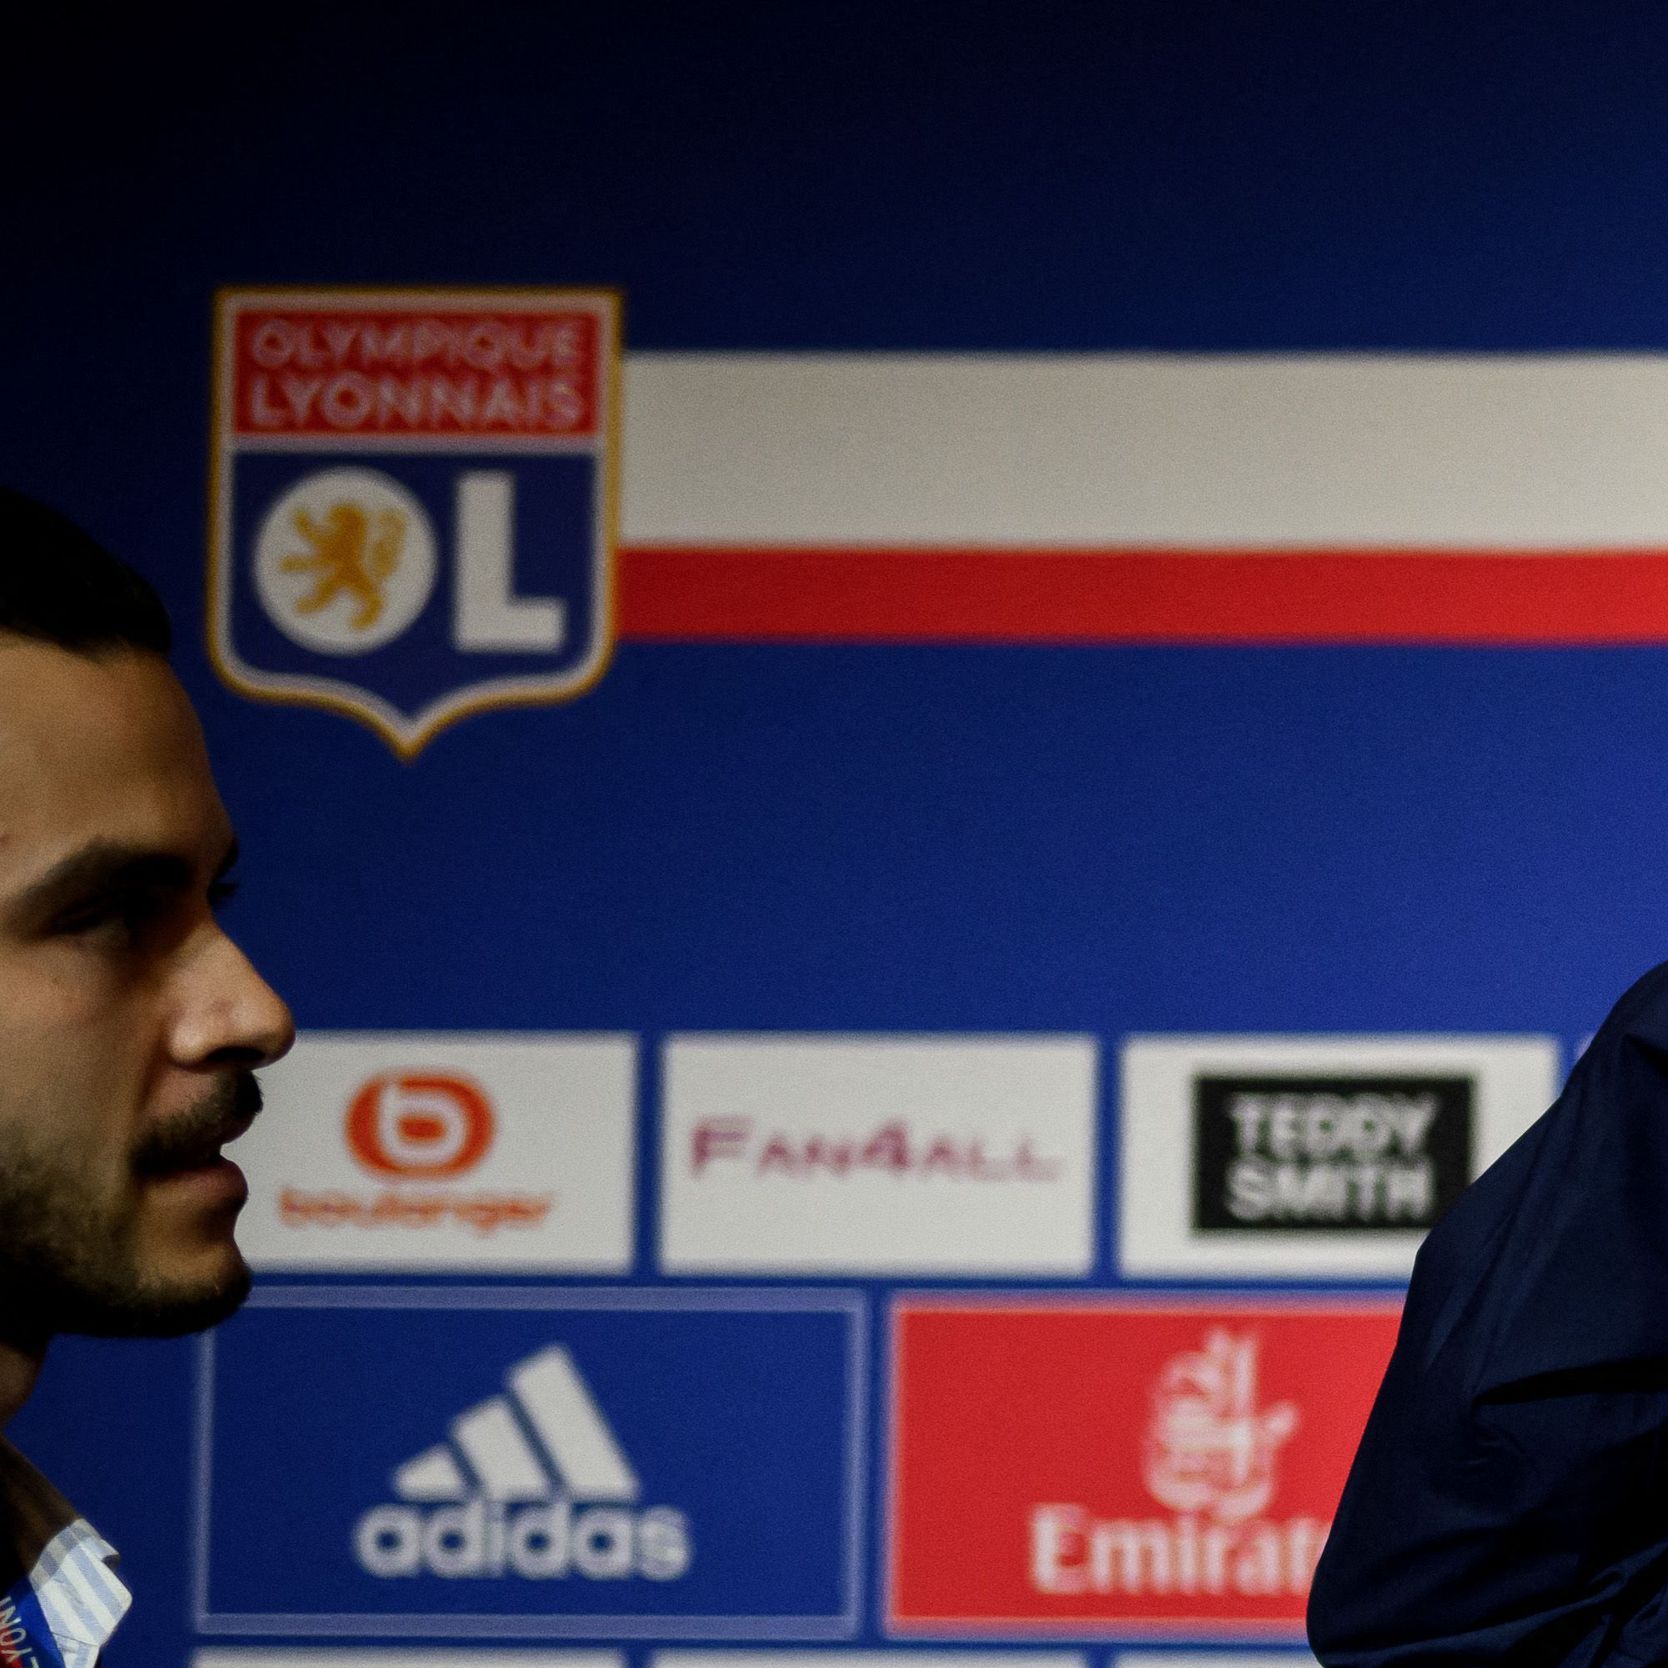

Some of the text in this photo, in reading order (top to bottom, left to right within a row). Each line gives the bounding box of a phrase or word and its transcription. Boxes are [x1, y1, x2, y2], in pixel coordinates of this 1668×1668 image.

[250, 317, 588, 373] OLYMPIQUE
[248, 371, 586, 429] LYONNAIS
[1228, 1092, 1436, 1160] TEDDY
[1224, 1160, 1434, 1223] SMITH
[354, 1497, 693, 1581] adidas
[1031, 1502, 1332, 1597] Emirat
